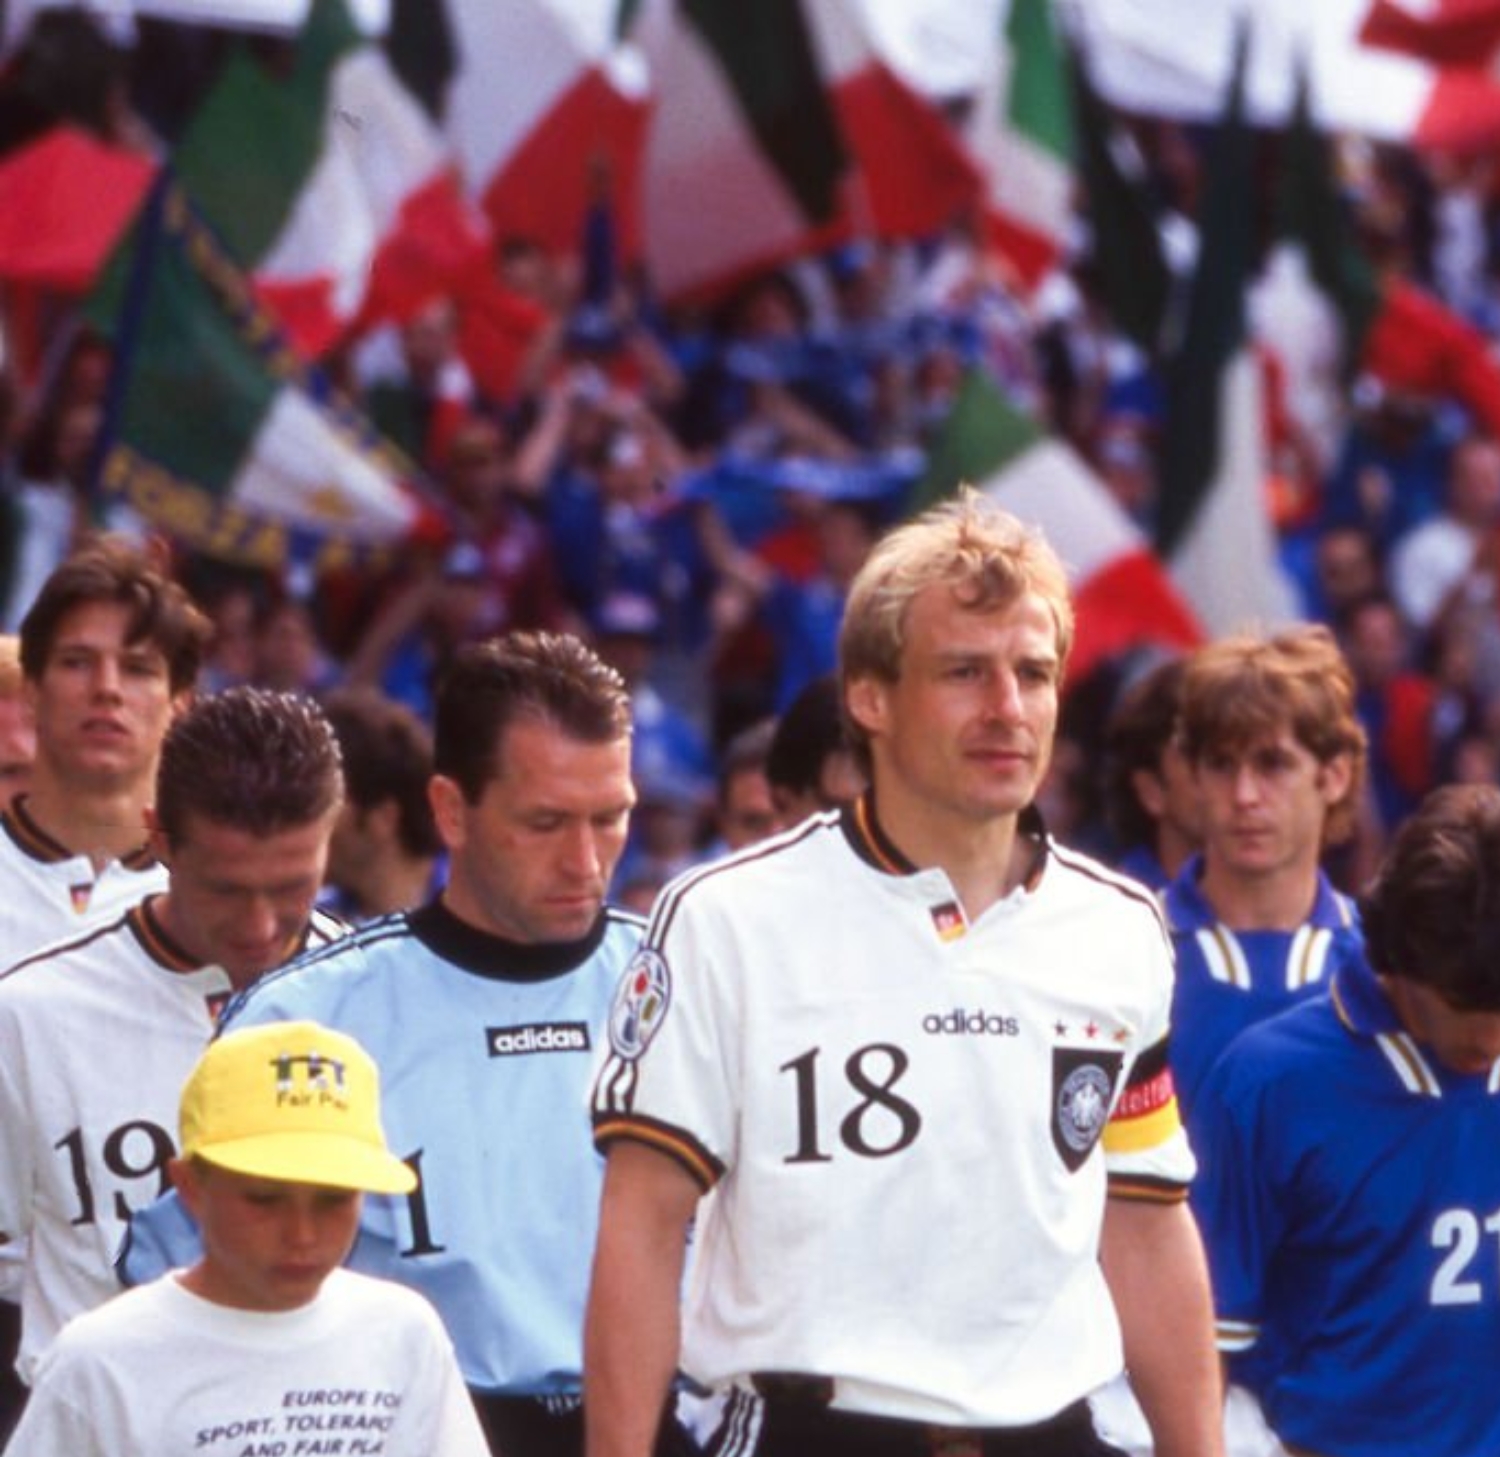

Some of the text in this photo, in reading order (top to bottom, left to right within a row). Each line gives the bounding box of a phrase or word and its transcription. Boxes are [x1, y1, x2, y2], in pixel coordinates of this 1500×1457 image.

[921, 1008, 1020, 1037] adidas
[494, 1026, 586, 1053] adidas
[780, 1043, 922, 1164] 18
[54, 1119, 177, 1226] 19
[401, 1147, 446, 1257] 1
[281, 1389, 370, 1408] EUROPE
[194, 1417, 276, 1448] SPORT,
[293, 1439, 345, 1457] FAIR
[348, 1437, 384, 1456] PLA
